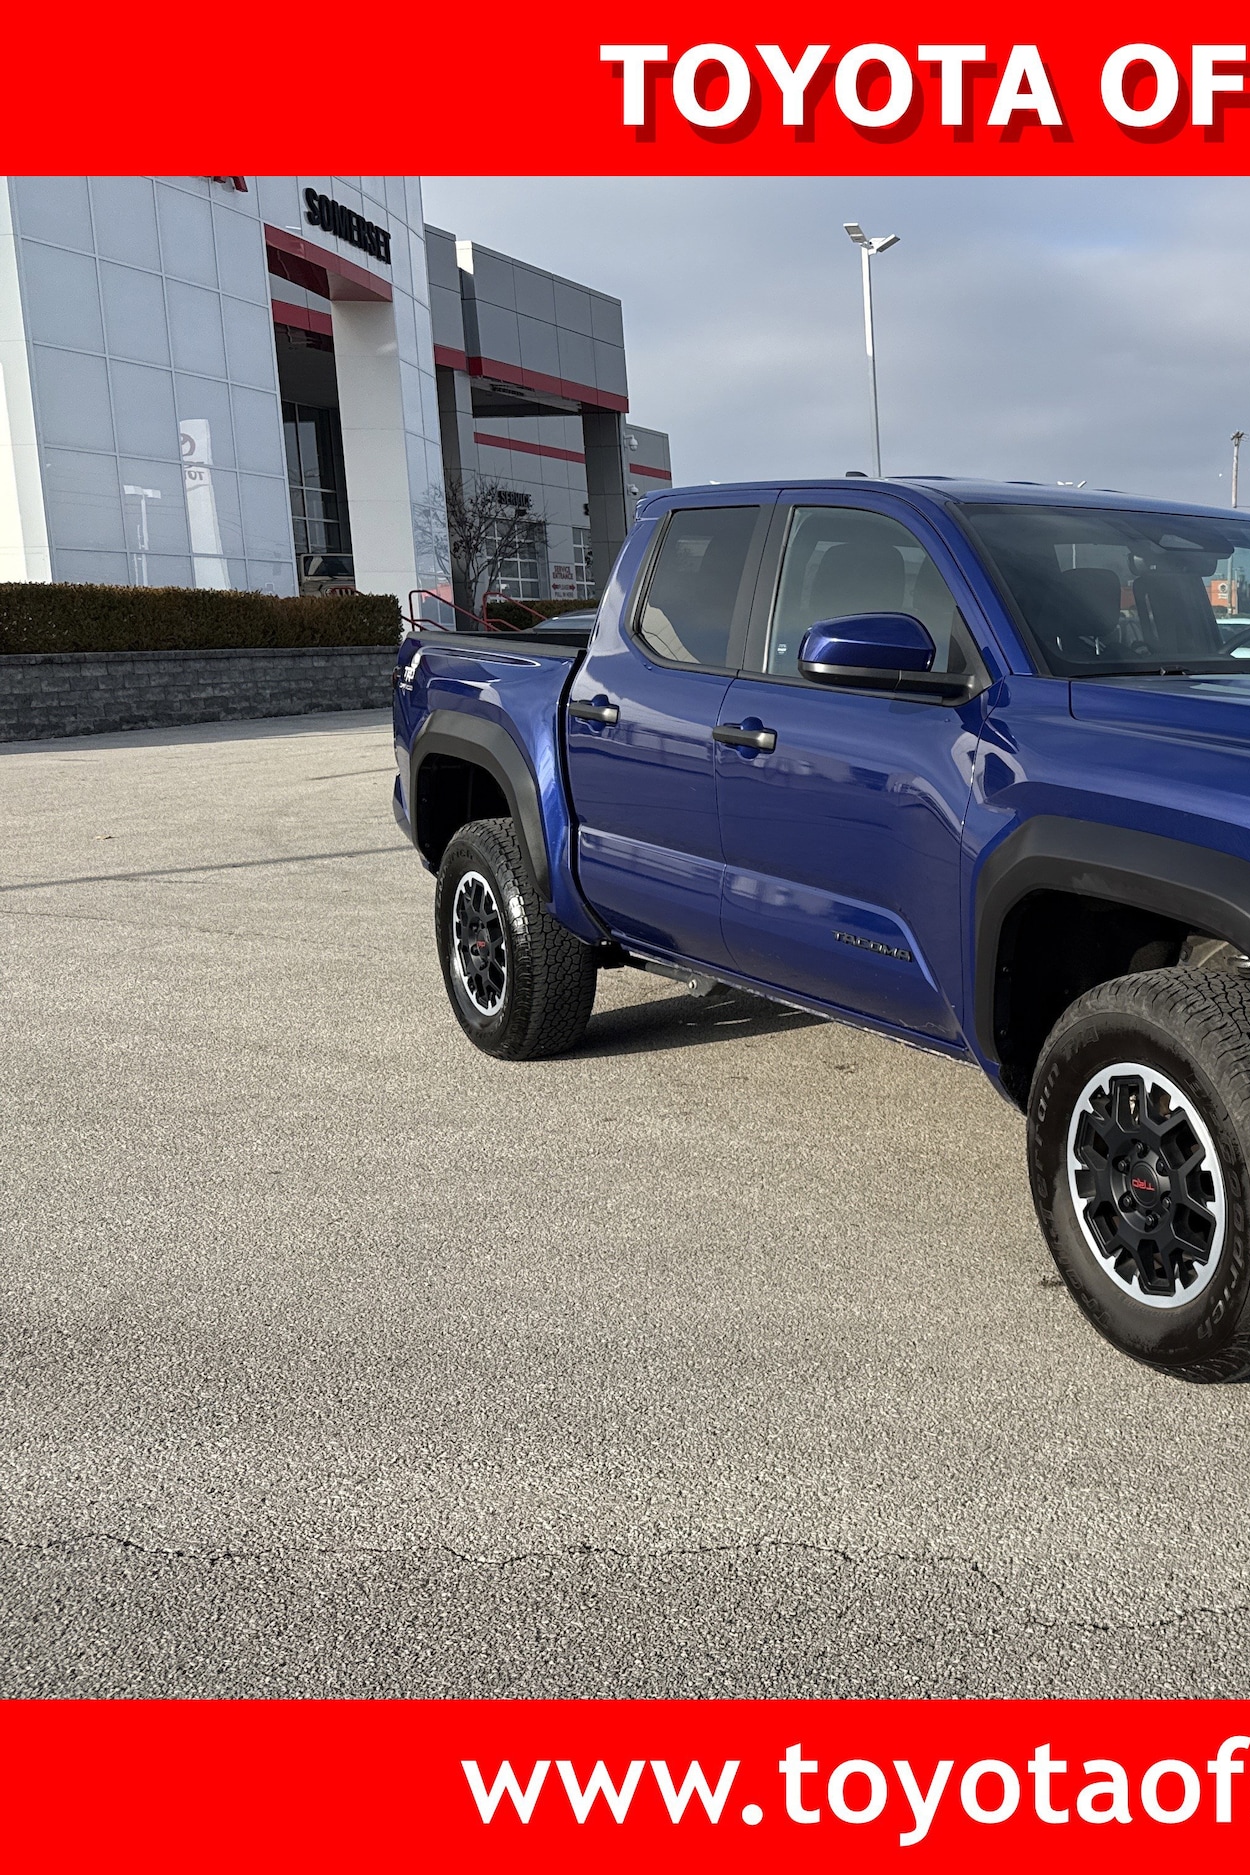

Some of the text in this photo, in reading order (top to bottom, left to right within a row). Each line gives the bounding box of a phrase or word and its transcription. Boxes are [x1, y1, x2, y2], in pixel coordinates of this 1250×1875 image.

[303, 187, 392, 265] SOMERSET
[831, 929, 912, 962] TACOMA
[1131, 1178, 1156, 1191] TRD
